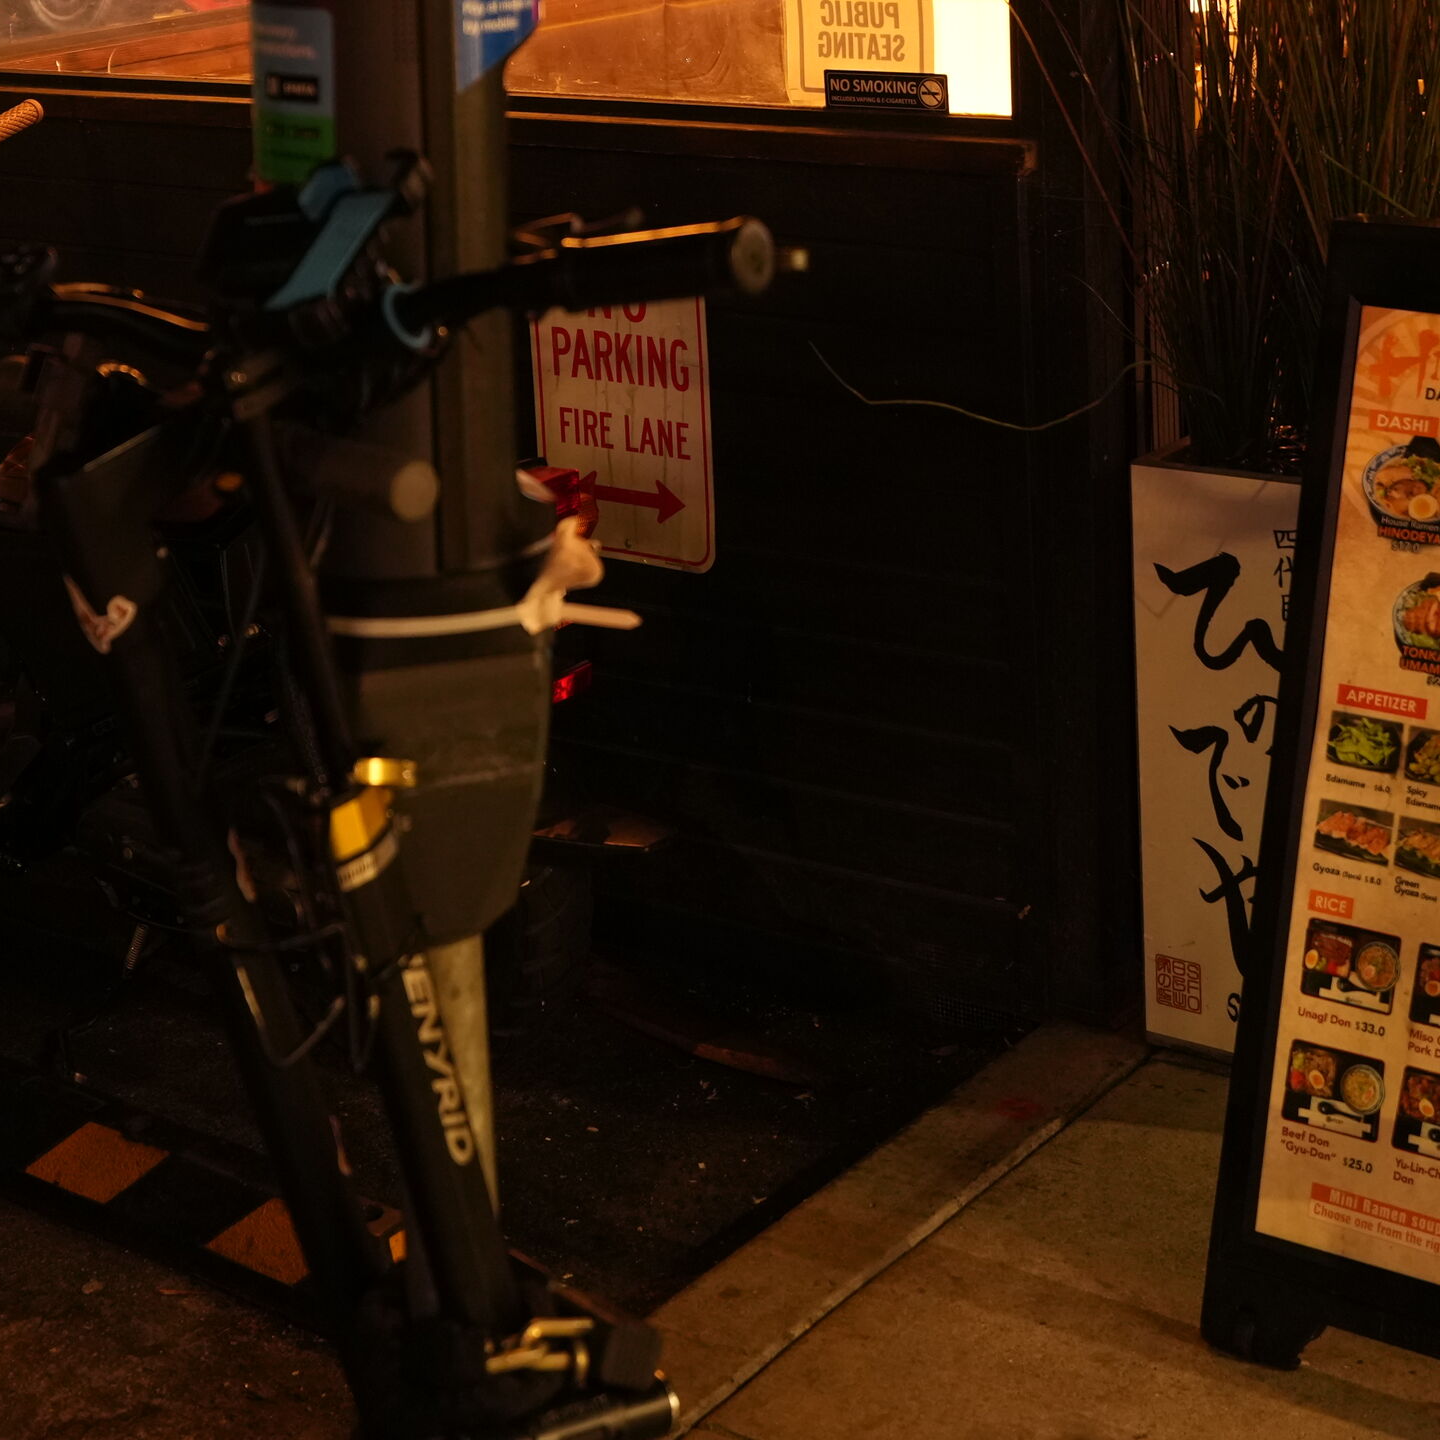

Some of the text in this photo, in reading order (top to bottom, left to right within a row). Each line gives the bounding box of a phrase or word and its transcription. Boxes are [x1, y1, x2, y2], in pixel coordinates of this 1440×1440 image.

[830, 79, 917, 94] NO SMOKING
[551, 327, 689, 392] PARKING
[1377, 415, 1429, 433] DASHI
[559, 407, 691, 460] FIRE LANE
[1378, 526, 1440, 544] HINODEYA
[1346, 689, 1417, 713] APPETIZER
[1326, 773, 1365, 790] Edamame
[1407, 786, 1427, 798] Spicy
[1313, 863, 1340, 876] Gyoza
[1394, 884, 1419, 898] Gyoza
[1395, 876, 1419, 889] Green
[1315, 896, 1347, 914] RICE
[1298, 1007, 1385, 1037] Unagi Don $33.0
[1409, 1028, 1433, 1043] Miso
[1408, 1042, 1431, 1056] Pork
[1281, 1126, 1329, 1148] Beef Don
[1343, 1157, 1373, 1174] $25.0
[1393, 1171, 1414, 1185] Don
[1329, 1188, 1358, 1209] Mini
[1363, 1198, 1406, 1225] Ramen
[1314, 1203, 1351, 1225] Choose
[1354, 1215, 1374, 1231] one
[1377, 1222, 1403, 1240] from
[1406, 1230, 1422, 1245] the
